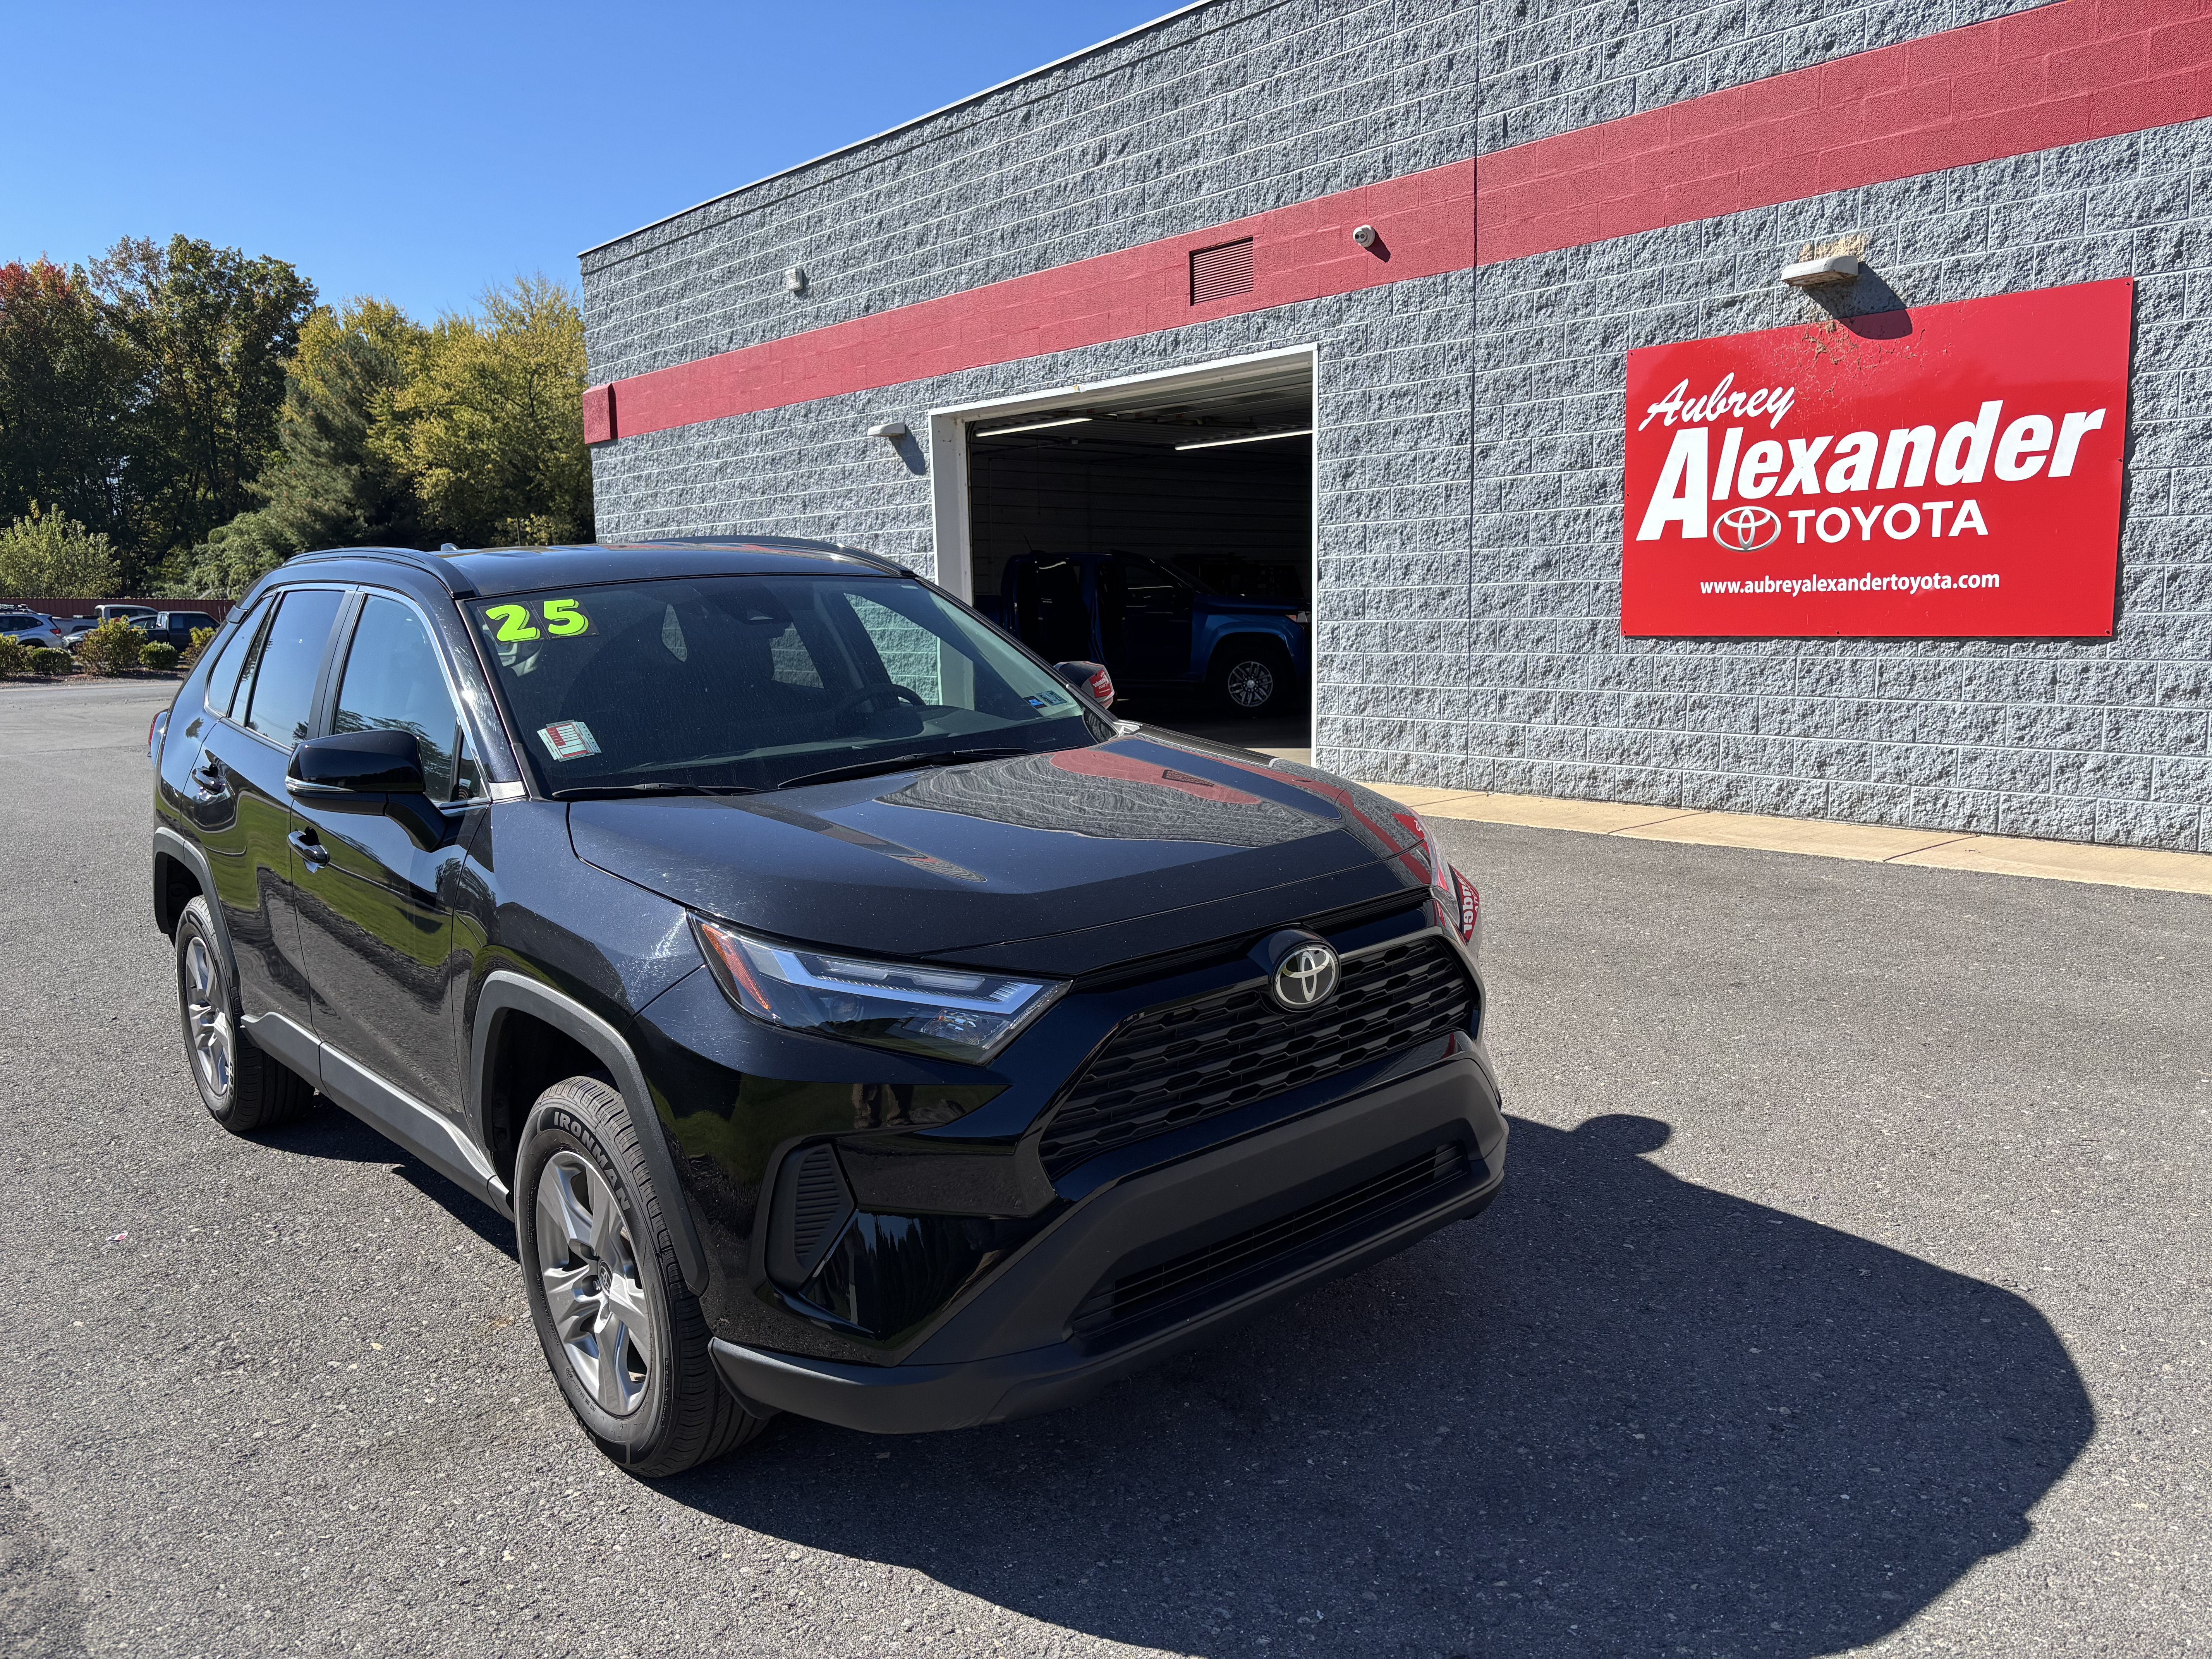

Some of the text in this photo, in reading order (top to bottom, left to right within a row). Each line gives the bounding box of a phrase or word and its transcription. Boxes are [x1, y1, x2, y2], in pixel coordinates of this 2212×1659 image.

[1638, 372, 1795, 431] Aubrey
[1636, 400, 2106, 541] Alexander
[1788, 499, 1989, 544] TOYOTA
[1700, 572, 2000, 597] www.aubreyalexandertoyota.com
[485, 599, 589, 642] 25
[554, 1111, 631, 1211] IRONMAN
